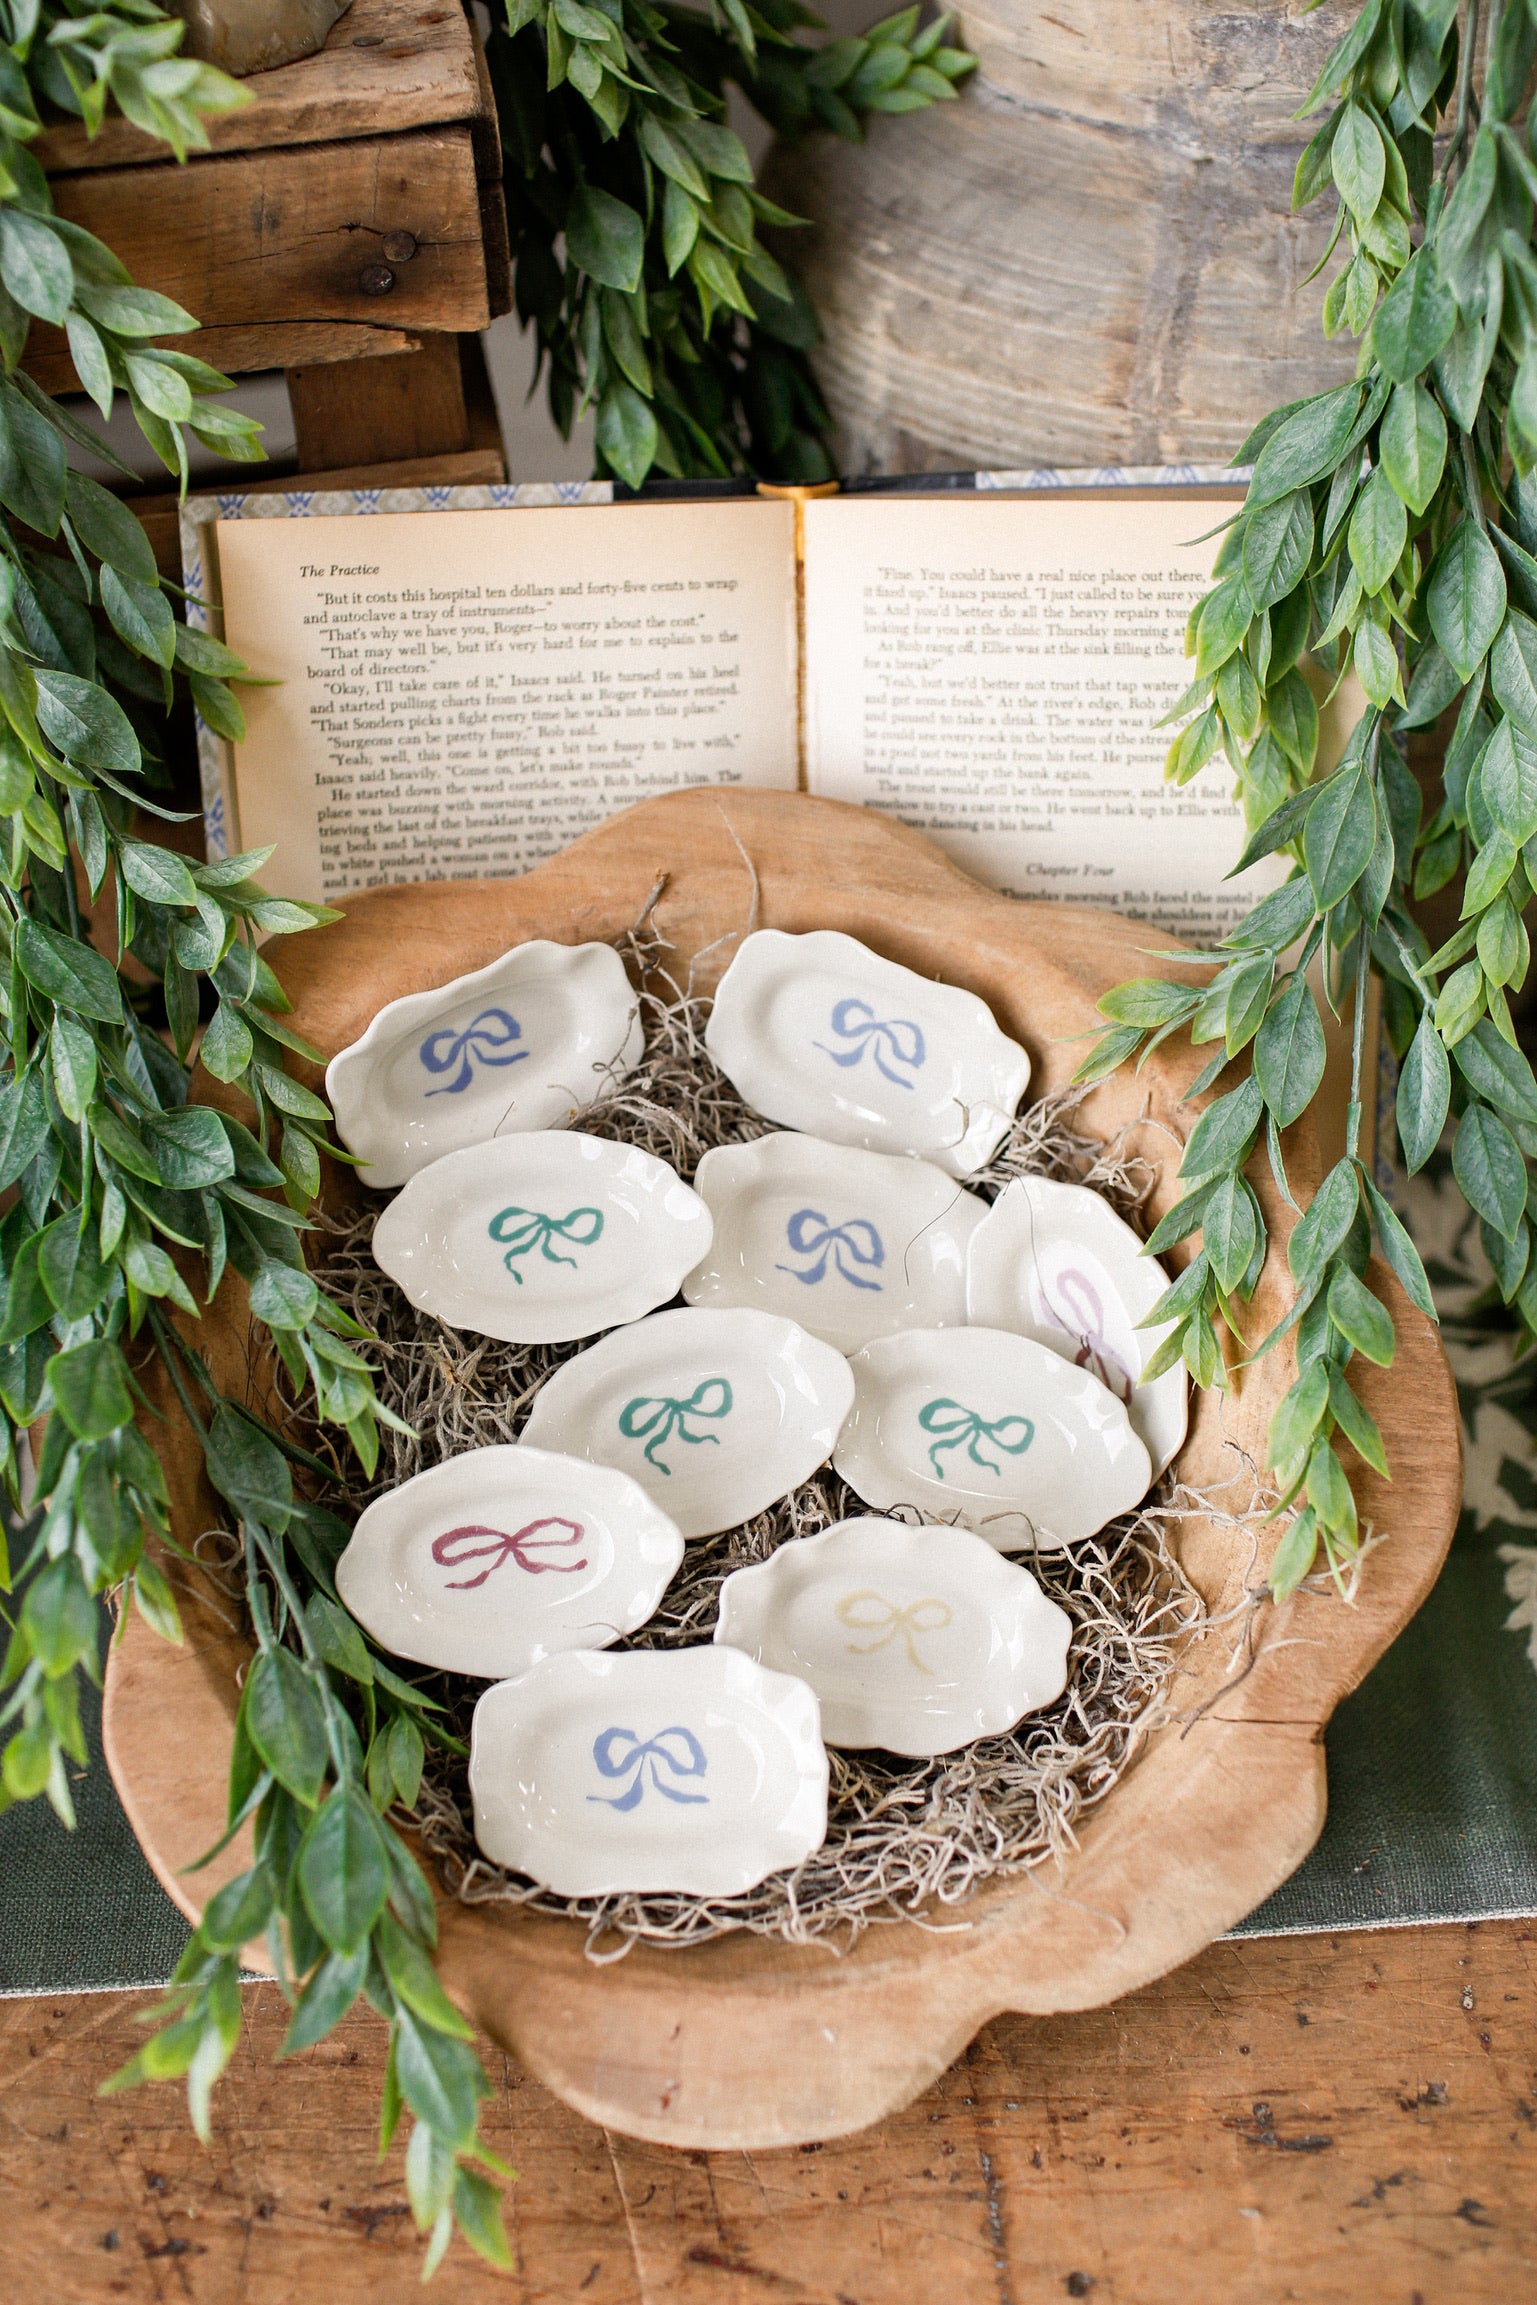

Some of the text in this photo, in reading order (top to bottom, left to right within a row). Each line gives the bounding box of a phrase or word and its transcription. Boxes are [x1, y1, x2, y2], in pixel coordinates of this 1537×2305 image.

[300, 565, 380, 577] The Practice
[990, 568, 1021, 581] have
[1027, 572, 1033, 581] a
[1039, 569, 1063, 581] real
[1069, 572, 1096, 581] nice
[1102, 569, 1136, 584] place
[1142, 572, 1162, 581] out
[1169, 569, 1206, 582] there,
[353, 580, 738, 604] it costs this hospital ten dollars and forty-five cents to wrap
[1051, 589, 1073, 601] just
[1078, 588, 1116, 600] called
[1121, 590, 1133, 599] to
[1138, 588, 1153, 600] be
[1158, 591, 1184, 600] sure
[304, 606, 455, 624] and autoclave a tray of
[1022, 606, 1037, 618] all
[1044, 606, 1063, 618] the
[1070, 606, 1107, 619] heavy
[1115, 607, 1158, 620] repairs
[372, 616, 665, 640] why we have you, worry about the
[1047, 625, 1106, 637] Thursday
[1114, 626, 1168, 638] morning
[365, 630, 738, 659] may well be, but it's very hard for me to explain to the
[1060, 642, 1079, 654] the
[1084, 643, 1108, 654] sink
[1114, 643, 1150, 656] filling
[1155, 643, 1179, 654] the
[307, 663, 363, 678] board of
[376, 668, 660, 692] I'll take care of He turned
[1051, 680, 1078, 690] trust
[1086, 679, 1111, 690] that
[1117, 680, 1137, 692] tap
[1143, 681, 1178, 691] water
[310, 701, 334, 714] and
[340, 699, 384, 712] started
[391, 697, 436, 713] pulling
[442, 695, 480, 708] charts
[486, 693, 516, 705] from
[523, 692, 541, 704] the
[600, 688, 637, 702] Roger
[409, 708, 578, 729] picks a fight every time he
[398, 731, 485, 745] can be pretty
[418, 750, 440, 761] this
[315, 773, 353, 785] Isaacs
[360, 771, 385, 782] said
[332, 789, 351, 801] He
[356, 786, 399, 799] started
[406, 785, 441, 797] down
[446, 782, 466, 793] the
[472, 781, 503, 792] ward
[719, 769, 742, 782] The
[318, 800, 474, 822] place was buzzing with
[319, 818, 460, 837] trieving the last of the
[320, 835, 461, 855] ing beds and helping
[322, 857, 374, 872] in white
[1026, 863, 1114, 876] Chapter Four
[323, 876, 347, 888] and
